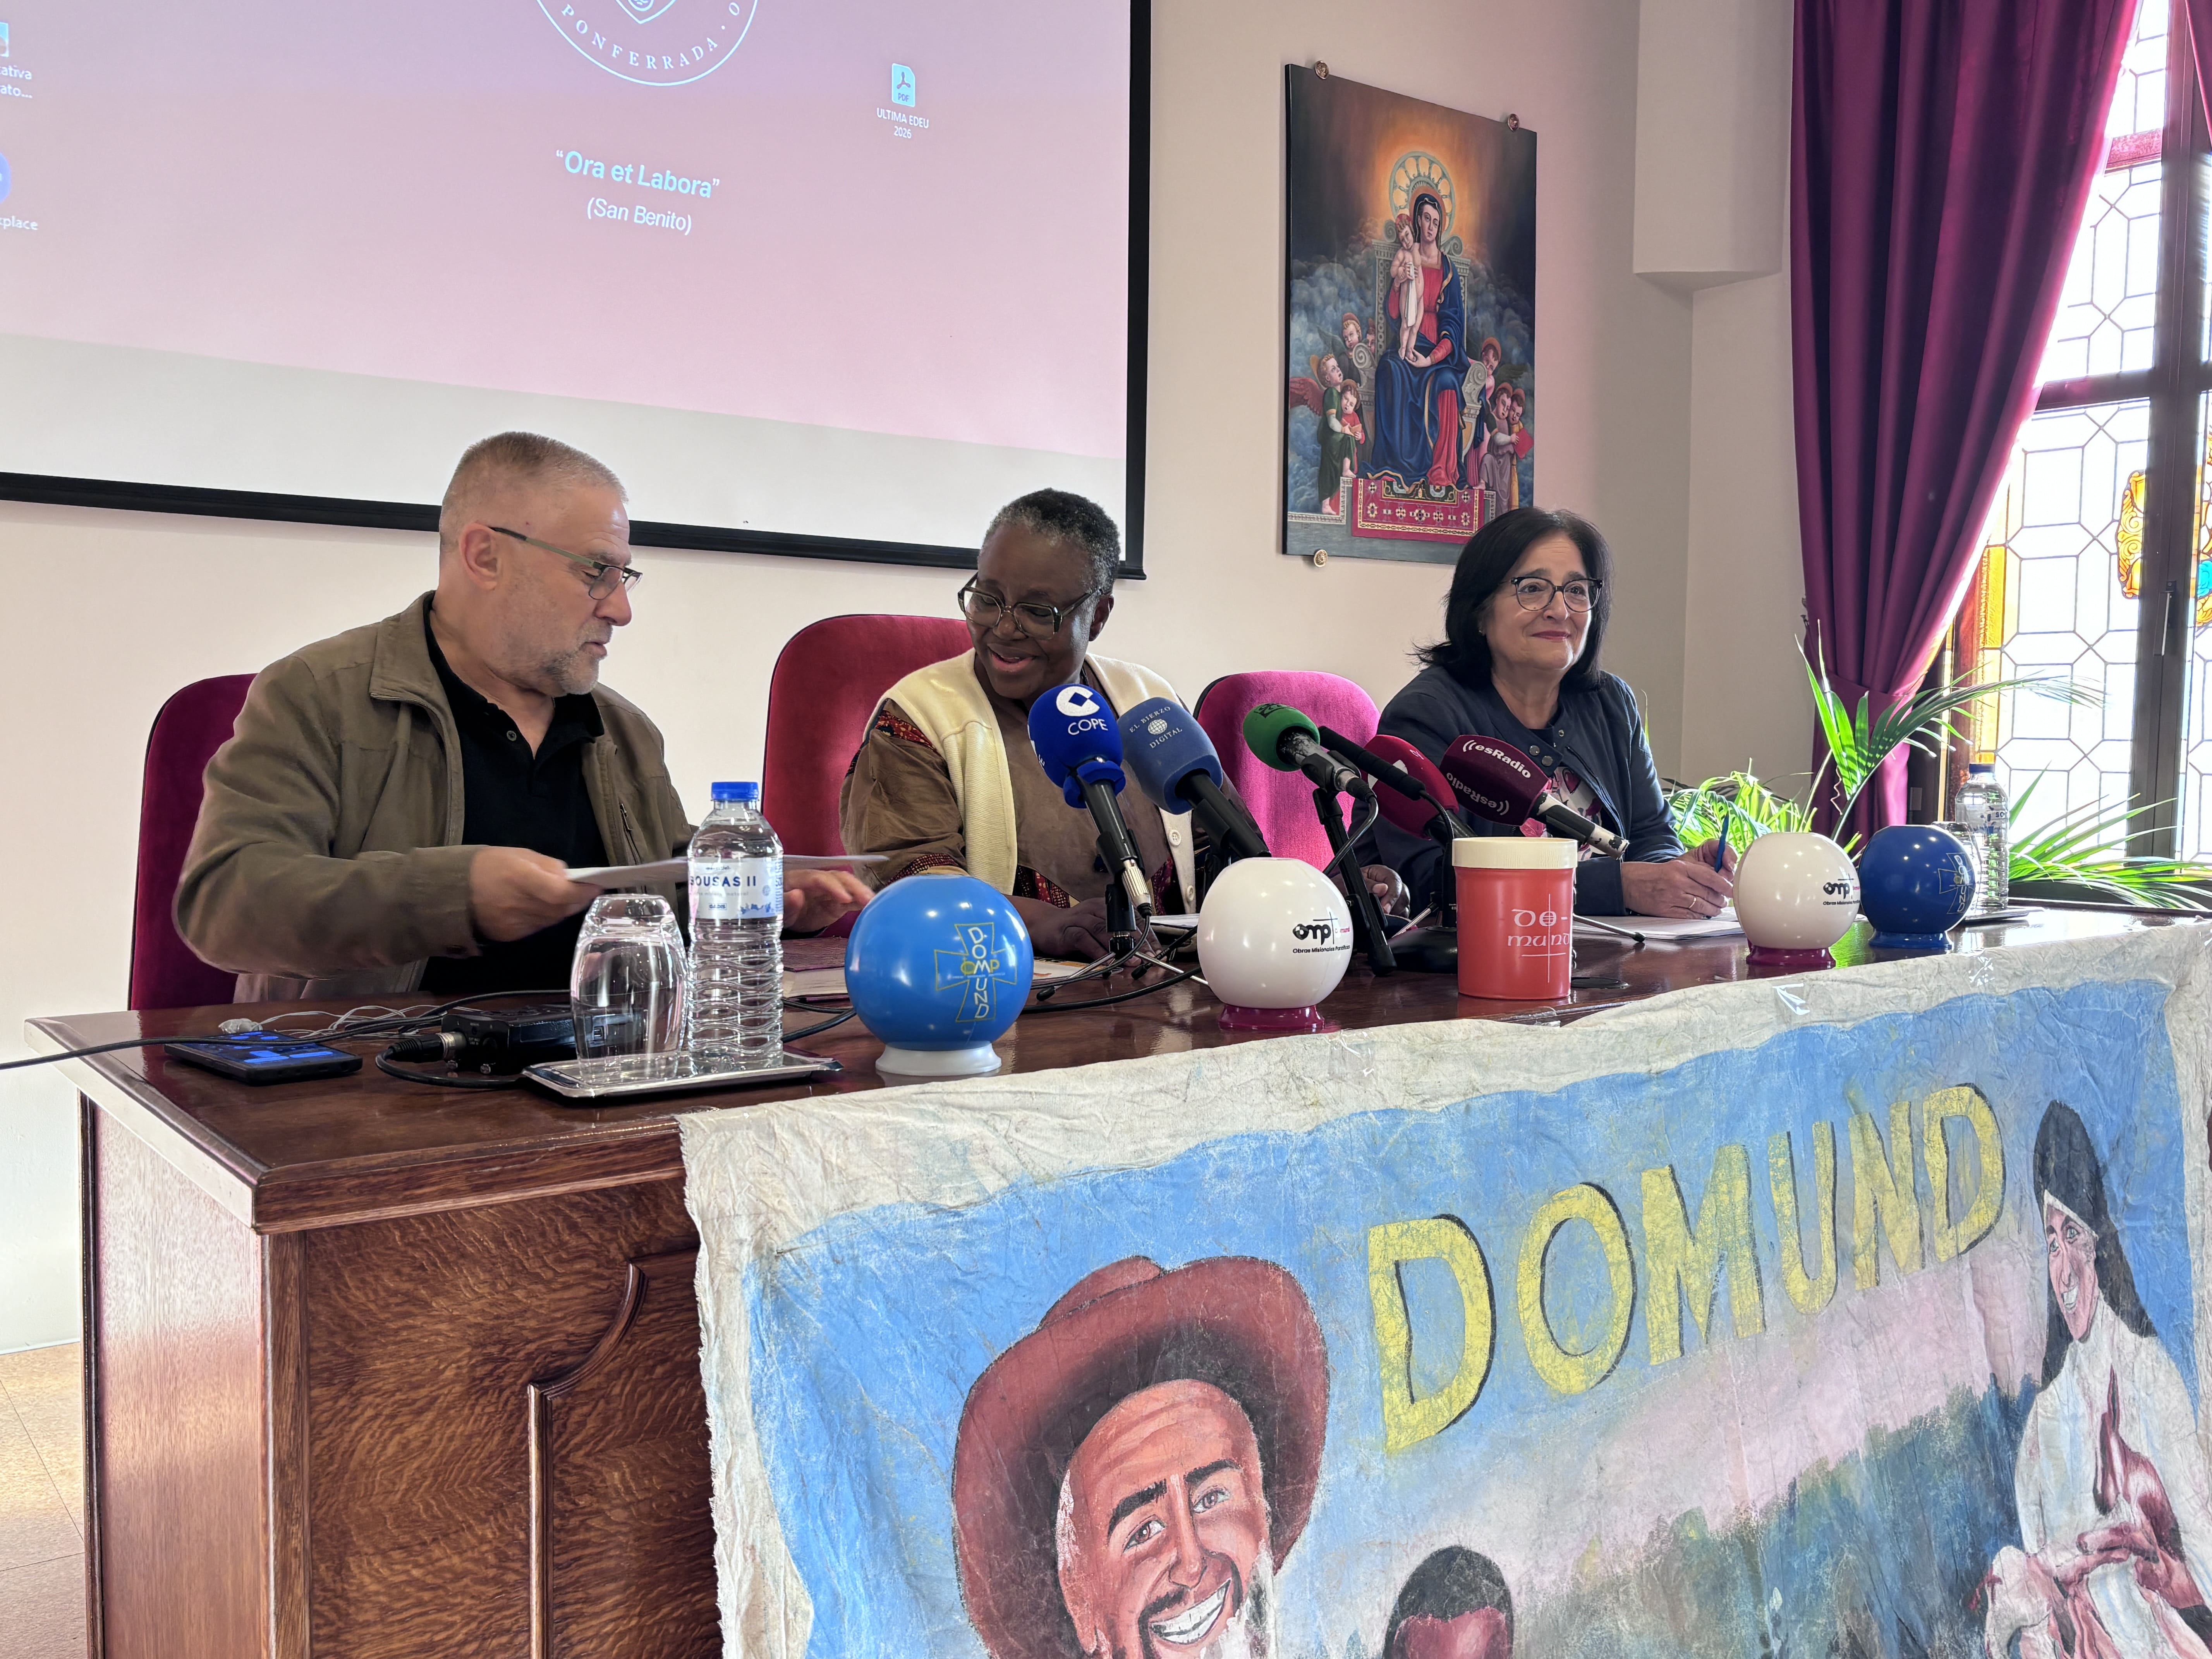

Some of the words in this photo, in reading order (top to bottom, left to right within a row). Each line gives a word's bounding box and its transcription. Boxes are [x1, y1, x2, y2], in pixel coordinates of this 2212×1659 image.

[562, 4, 718, 69] PONFERRADA
[0, 65, 32, 80] ativa
[898, 93, 910, 102] PDF
[877, 107, 907, 124] ULTIMA
[909, 115, 929, 129] EDEU
[894, 125, 912, 139] 2026
[611, 164, 633, 184] et
[587, 198, 629, 221] (San
[634, 205, 692, 235] Benito)
[1068, 718, 1108, 735] COPE
[1129, 724, 1140, 733] EL
[1140, 706, 1171, 723] BIERZO
[1149, 727, 1182, 749] DIGITAL
[968, 927, 989, 1018] DOMUND
[1368, 1083, 2006, 1453] DOMUND
